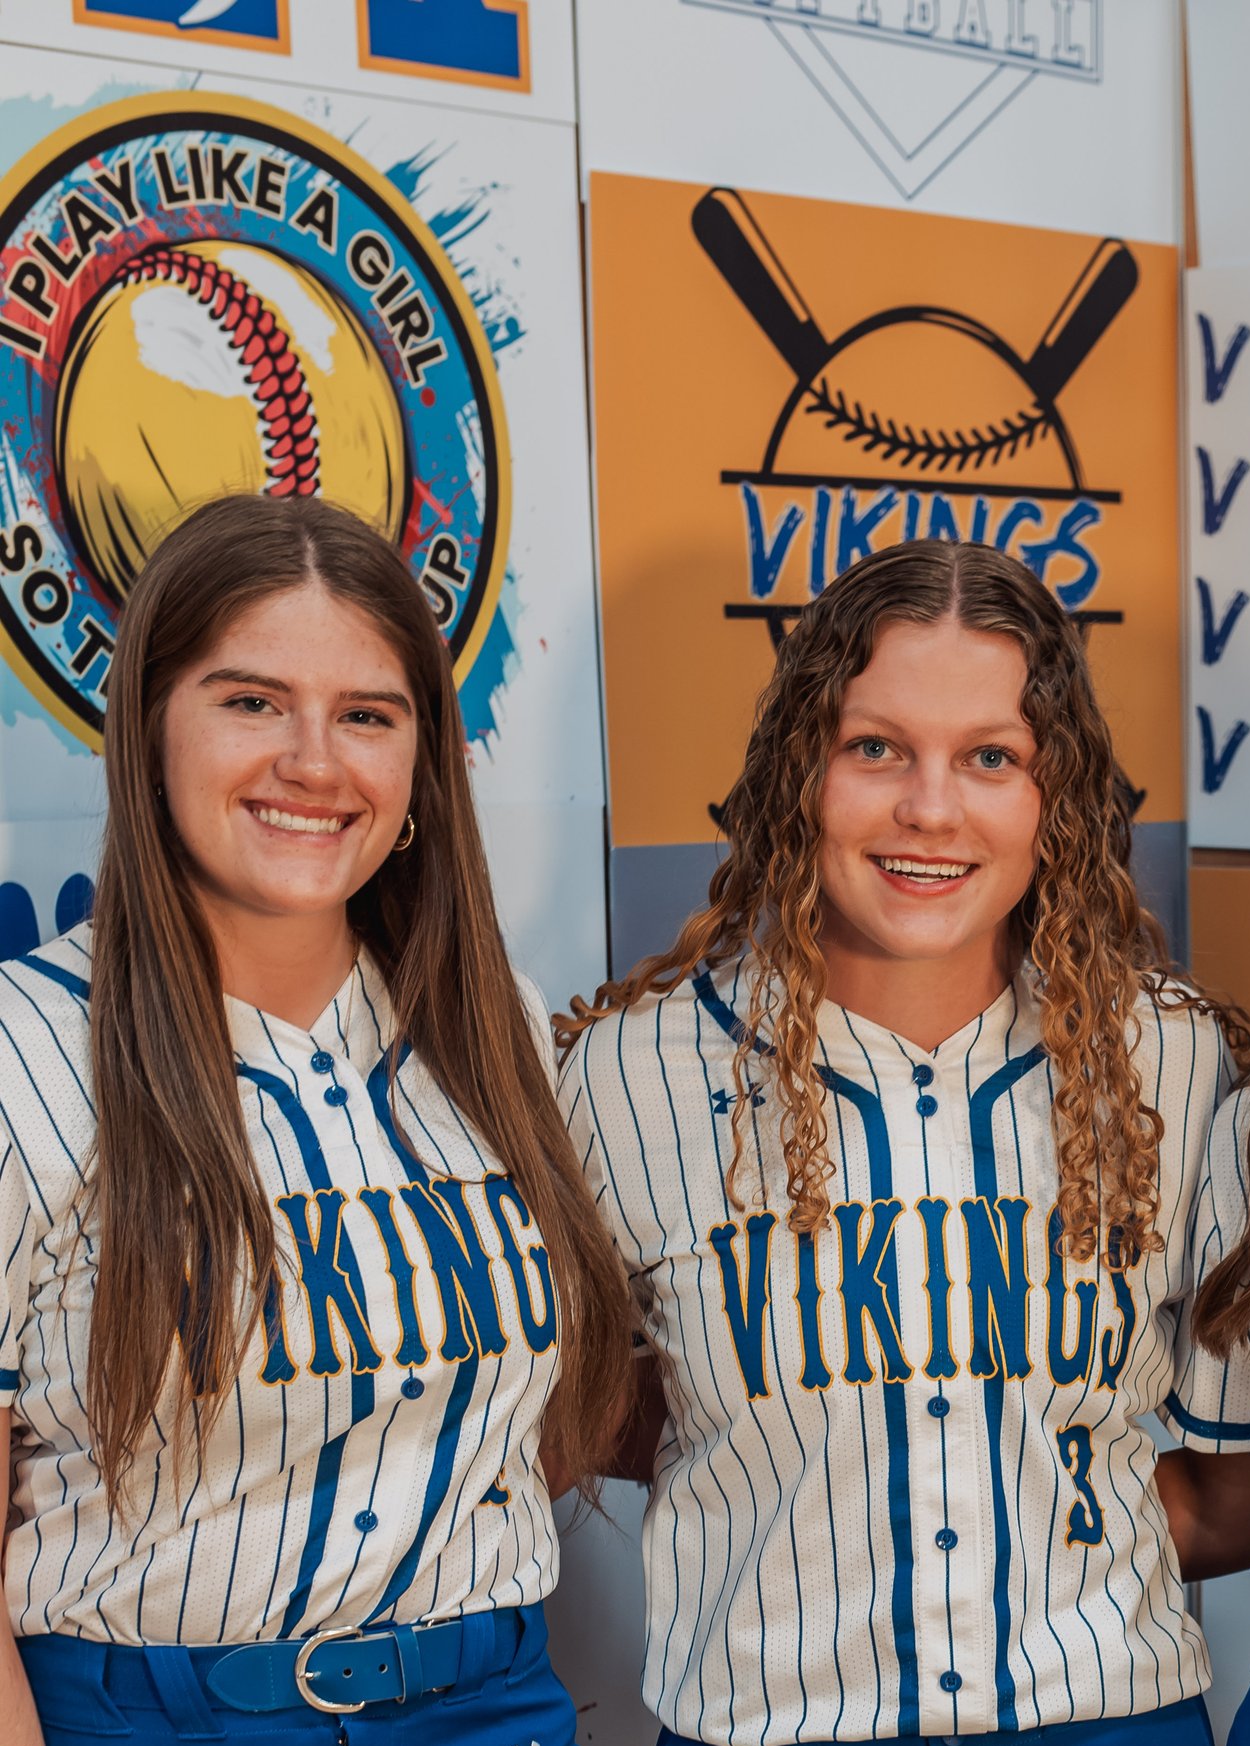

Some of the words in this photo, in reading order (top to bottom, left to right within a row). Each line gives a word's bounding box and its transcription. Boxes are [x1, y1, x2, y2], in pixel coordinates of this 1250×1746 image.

[5, 156, 143, 326] PLAY
[151, 143, 290, 222] LIKE
[290, 185, 337, 256] A
[346, 229, 448, 389] GIRL
[707, 1196, 1142, 1402] VIKINGS
[1056, 1421, 1106, 1551] 3
